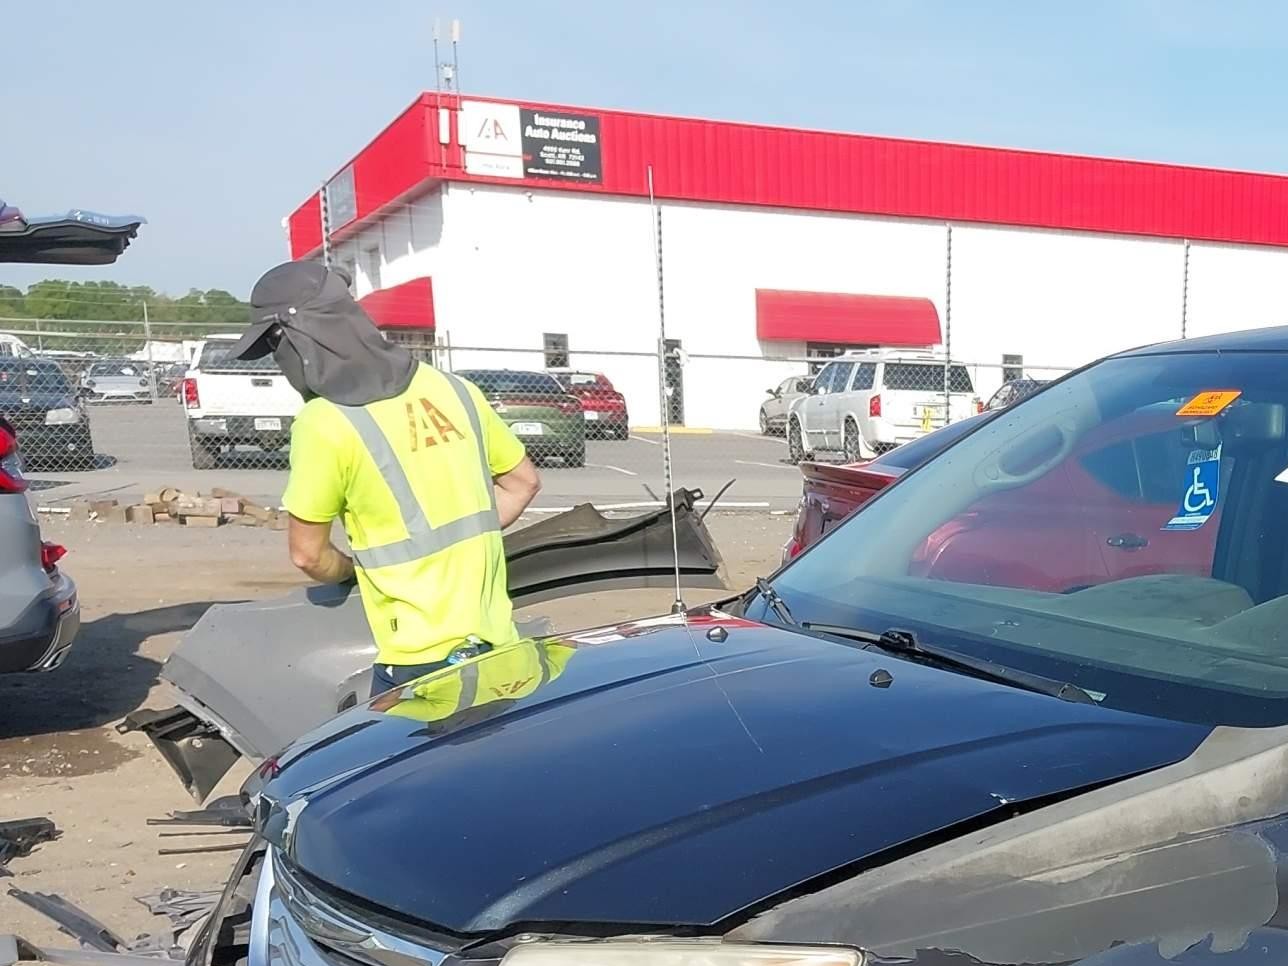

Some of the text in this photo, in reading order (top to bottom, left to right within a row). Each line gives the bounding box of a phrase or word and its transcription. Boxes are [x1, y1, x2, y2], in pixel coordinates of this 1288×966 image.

[534, 113, 586, 130] Insurance
[525, 125, 596, 143] Auto Auctions
